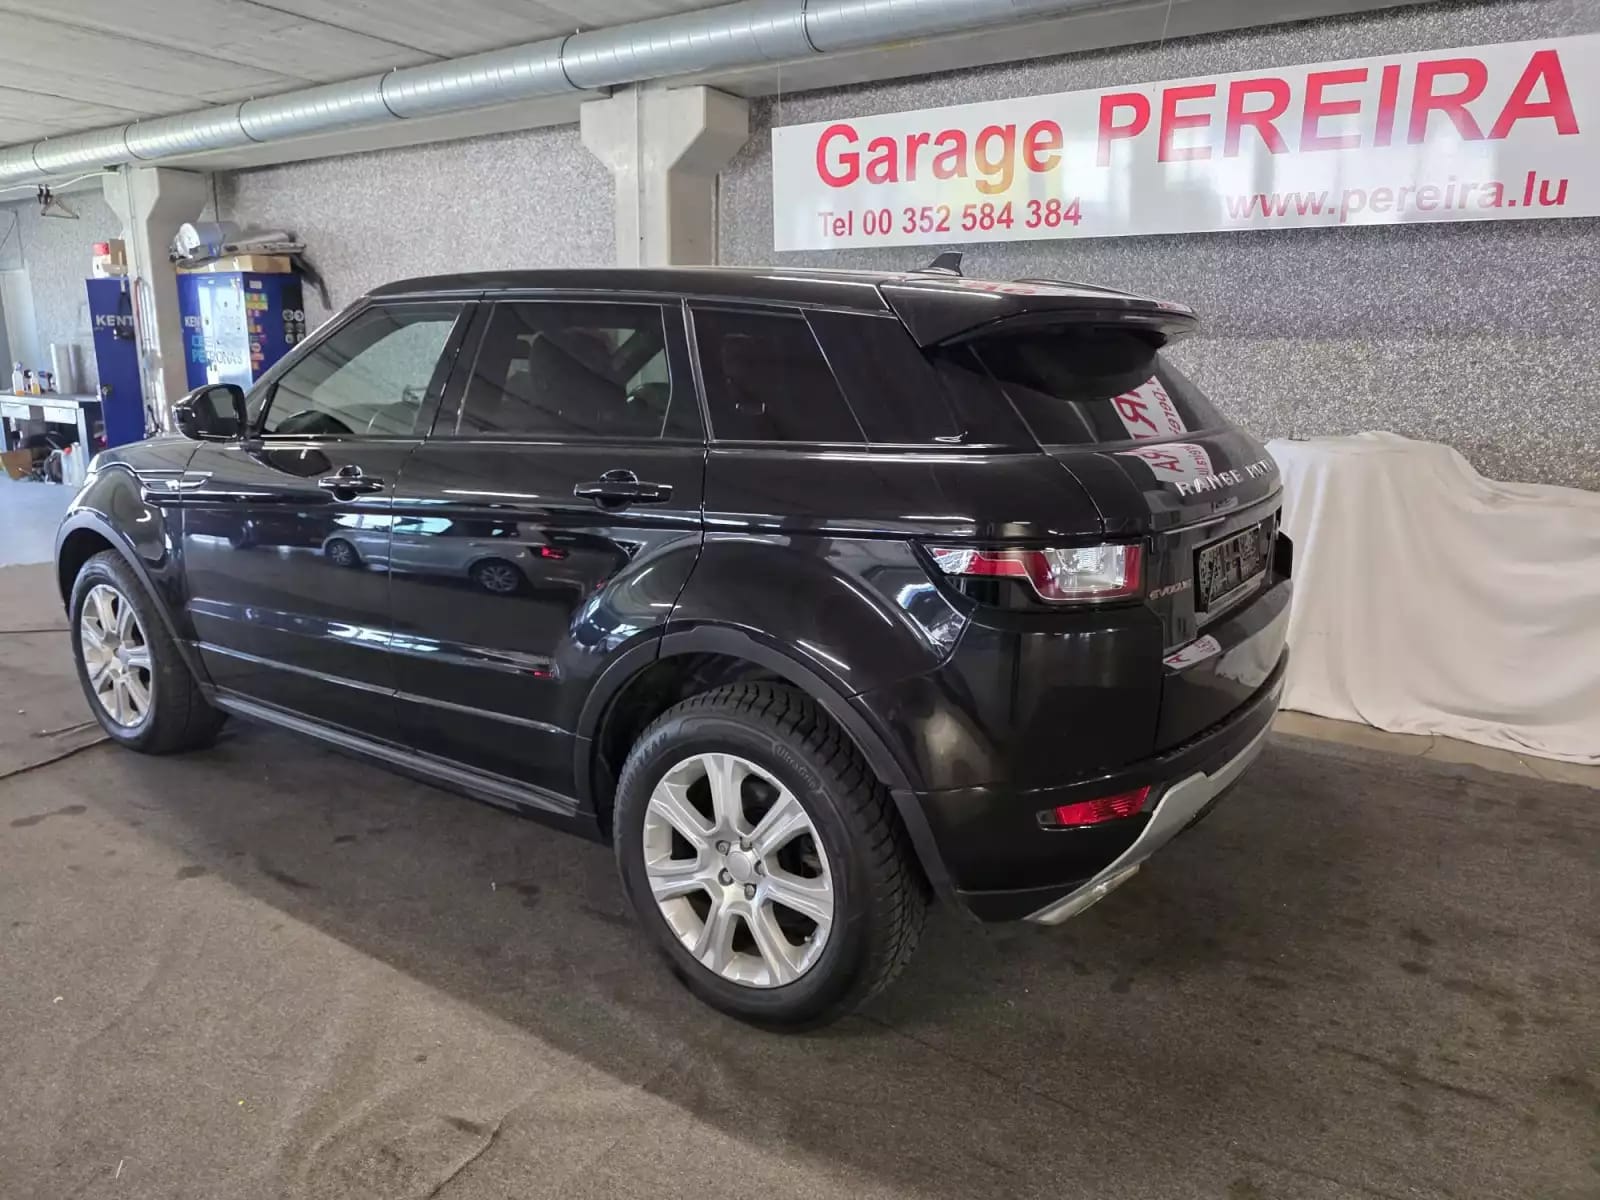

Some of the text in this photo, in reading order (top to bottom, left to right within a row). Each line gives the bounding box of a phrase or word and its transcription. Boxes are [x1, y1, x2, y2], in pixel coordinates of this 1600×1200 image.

[816, 49, 1580, 195] Garage PEREIRA
[818, 196, 1082, 238] Tel 00 352 584 384
[1228, 171, 1569, 223] www.pereira.lu
[95, 314, 134, 327] KENT
[1174, 469, 1244, 497] RANGE
